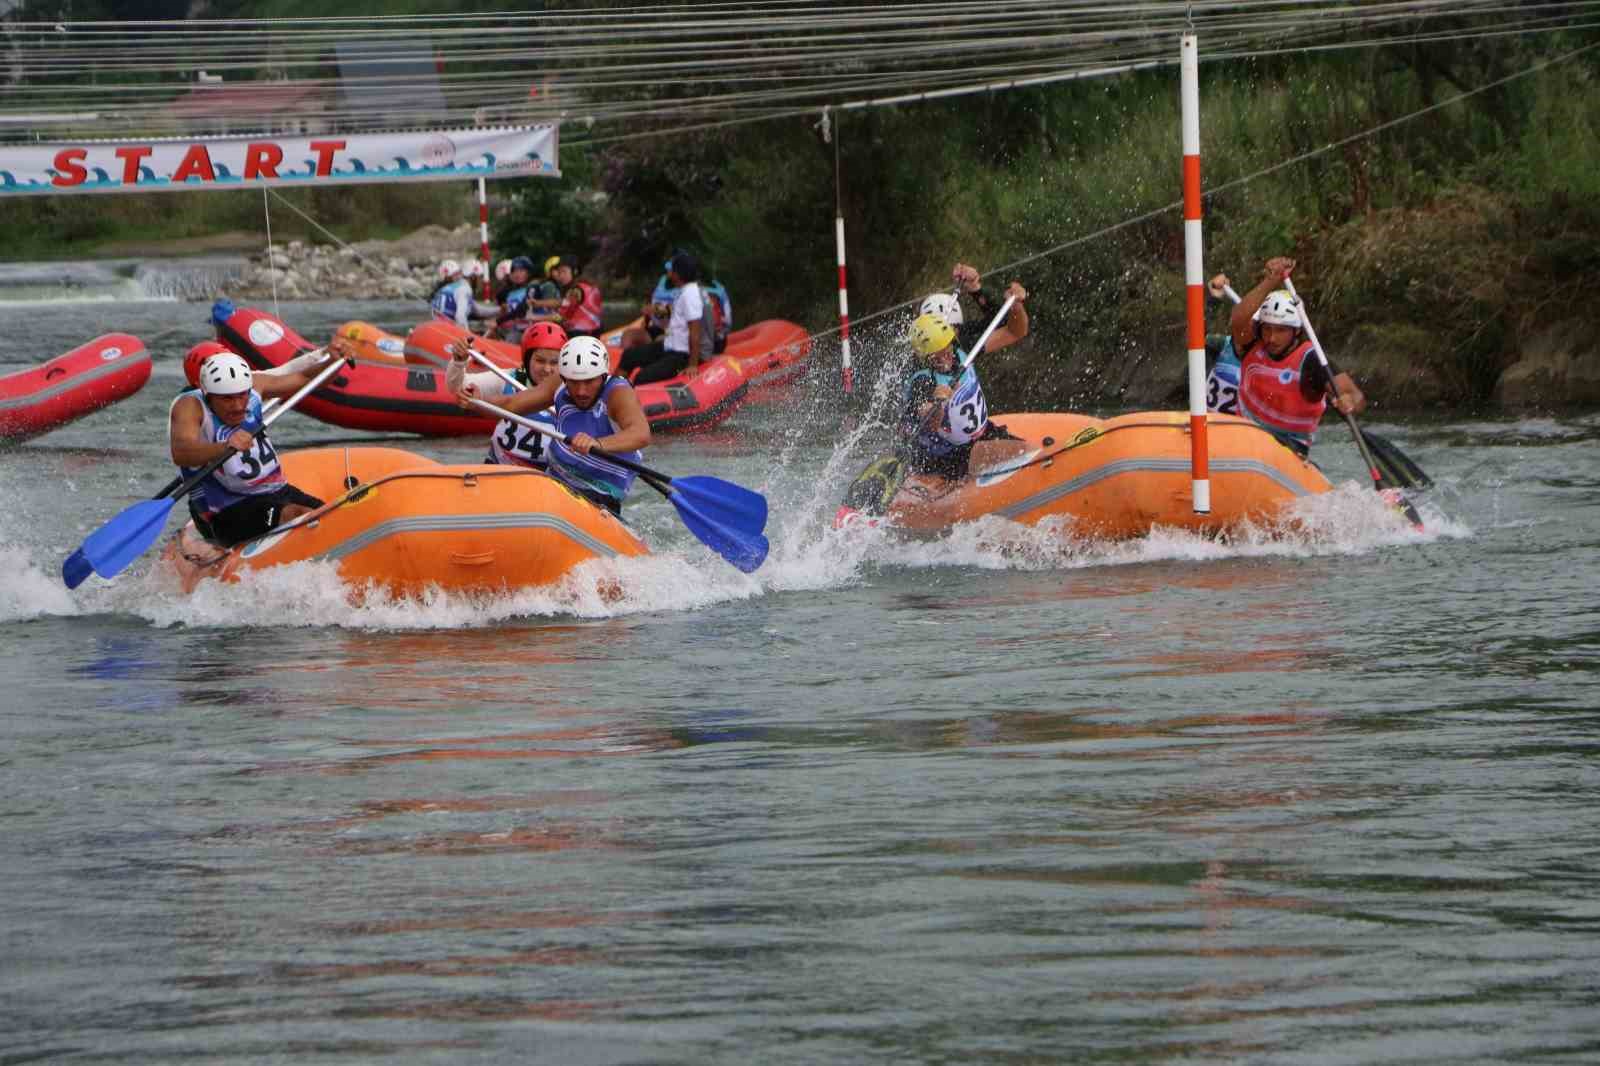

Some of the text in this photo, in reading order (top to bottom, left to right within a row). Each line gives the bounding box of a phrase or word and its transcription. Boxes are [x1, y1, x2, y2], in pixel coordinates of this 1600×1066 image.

[51, 140, 347, 187] START
[1207, 377, 1238, 414] 32
[237, 432, 278, 480] 34
[497, 417, 545, 459] 34
